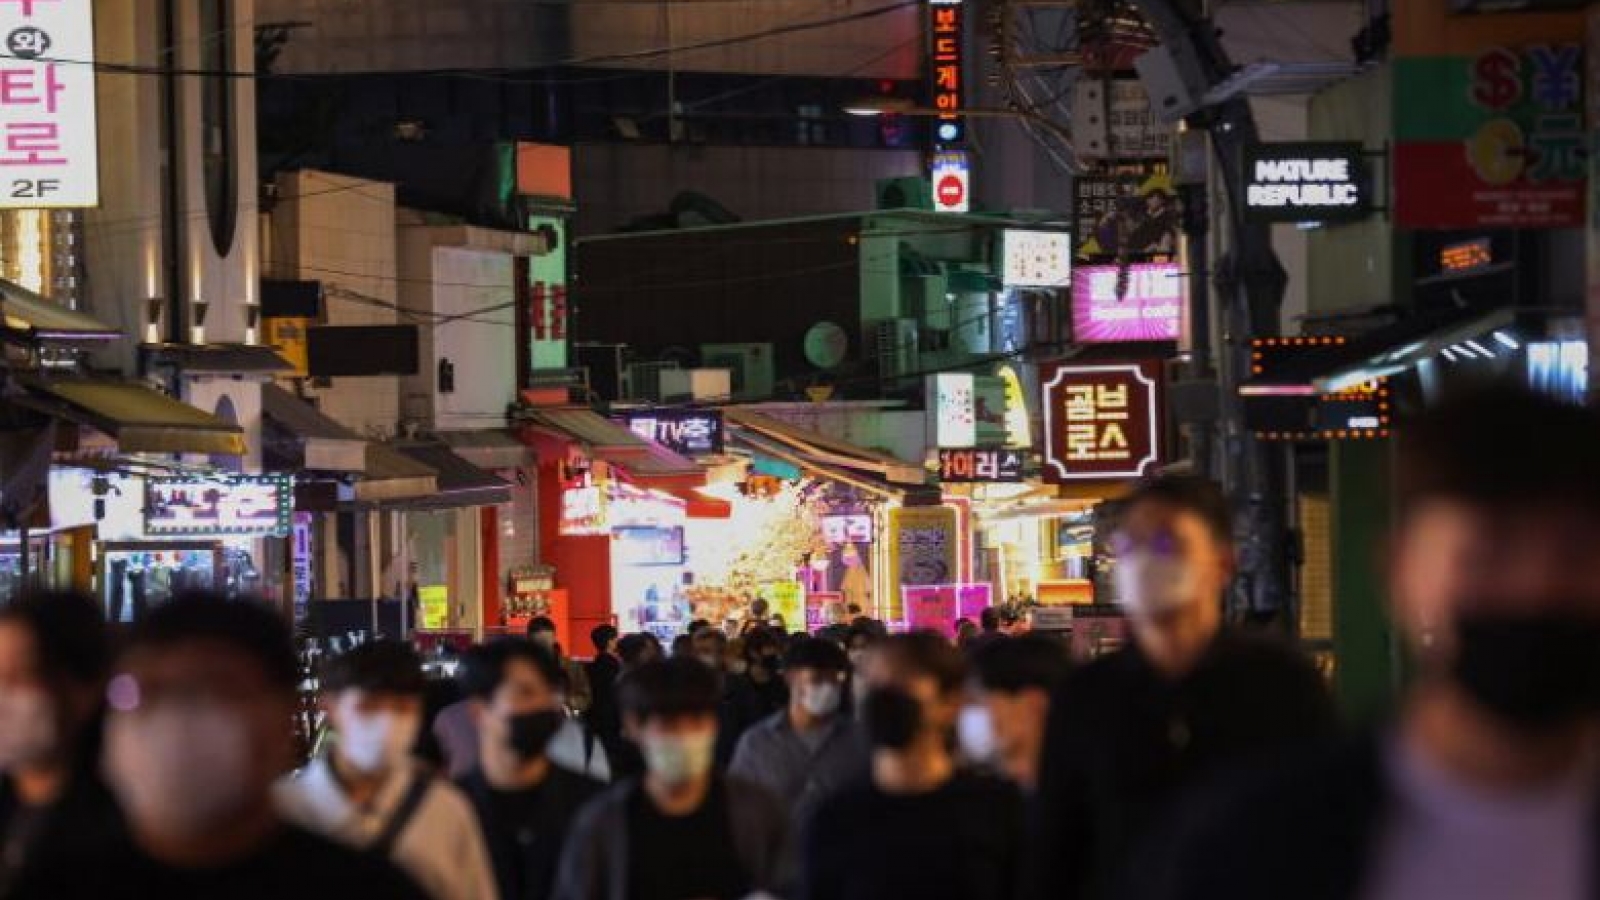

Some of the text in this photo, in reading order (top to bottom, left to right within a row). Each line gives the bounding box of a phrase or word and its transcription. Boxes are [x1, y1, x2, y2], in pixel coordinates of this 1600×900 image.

[0, 61, 68, 167] 타로
[1254, 158, 1349, 182] NATURE
[11, 179, 60, 198] 2F
[1247, 183, 1358, 206] REPUBLIC
[1064, 383, 1129, 421] 곰브
[1065, 422, 1131, 461] 로스
